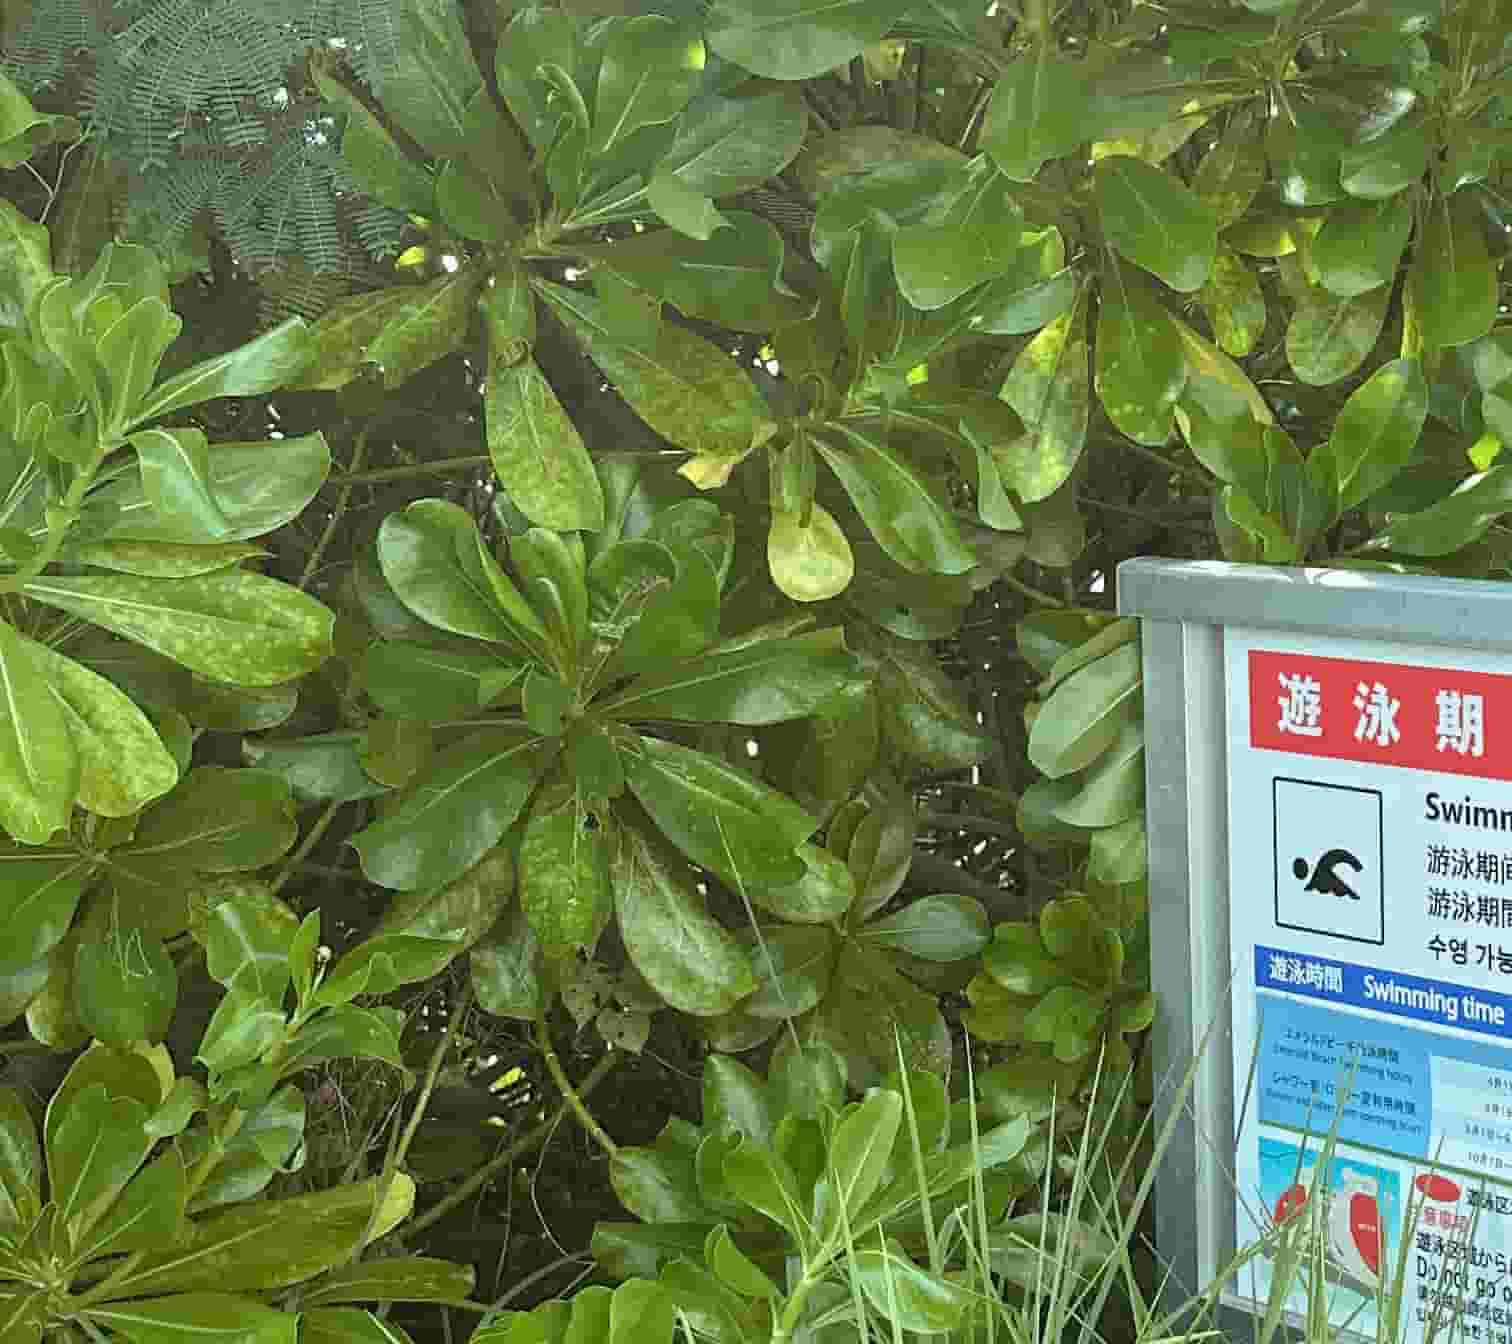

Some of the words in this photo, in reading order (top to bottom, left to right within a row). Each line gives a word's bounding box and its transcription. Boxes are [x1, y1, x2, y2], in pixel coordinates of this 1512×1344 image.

[1427, 931, 1467, 965] 수영
[1363, 973, 1457, 1020] Swimming
[1461, 994, 1504, 1027] time
[1416, 1255, 1436, 1281] Do
[1477, 1277, 1495, 1302] go
